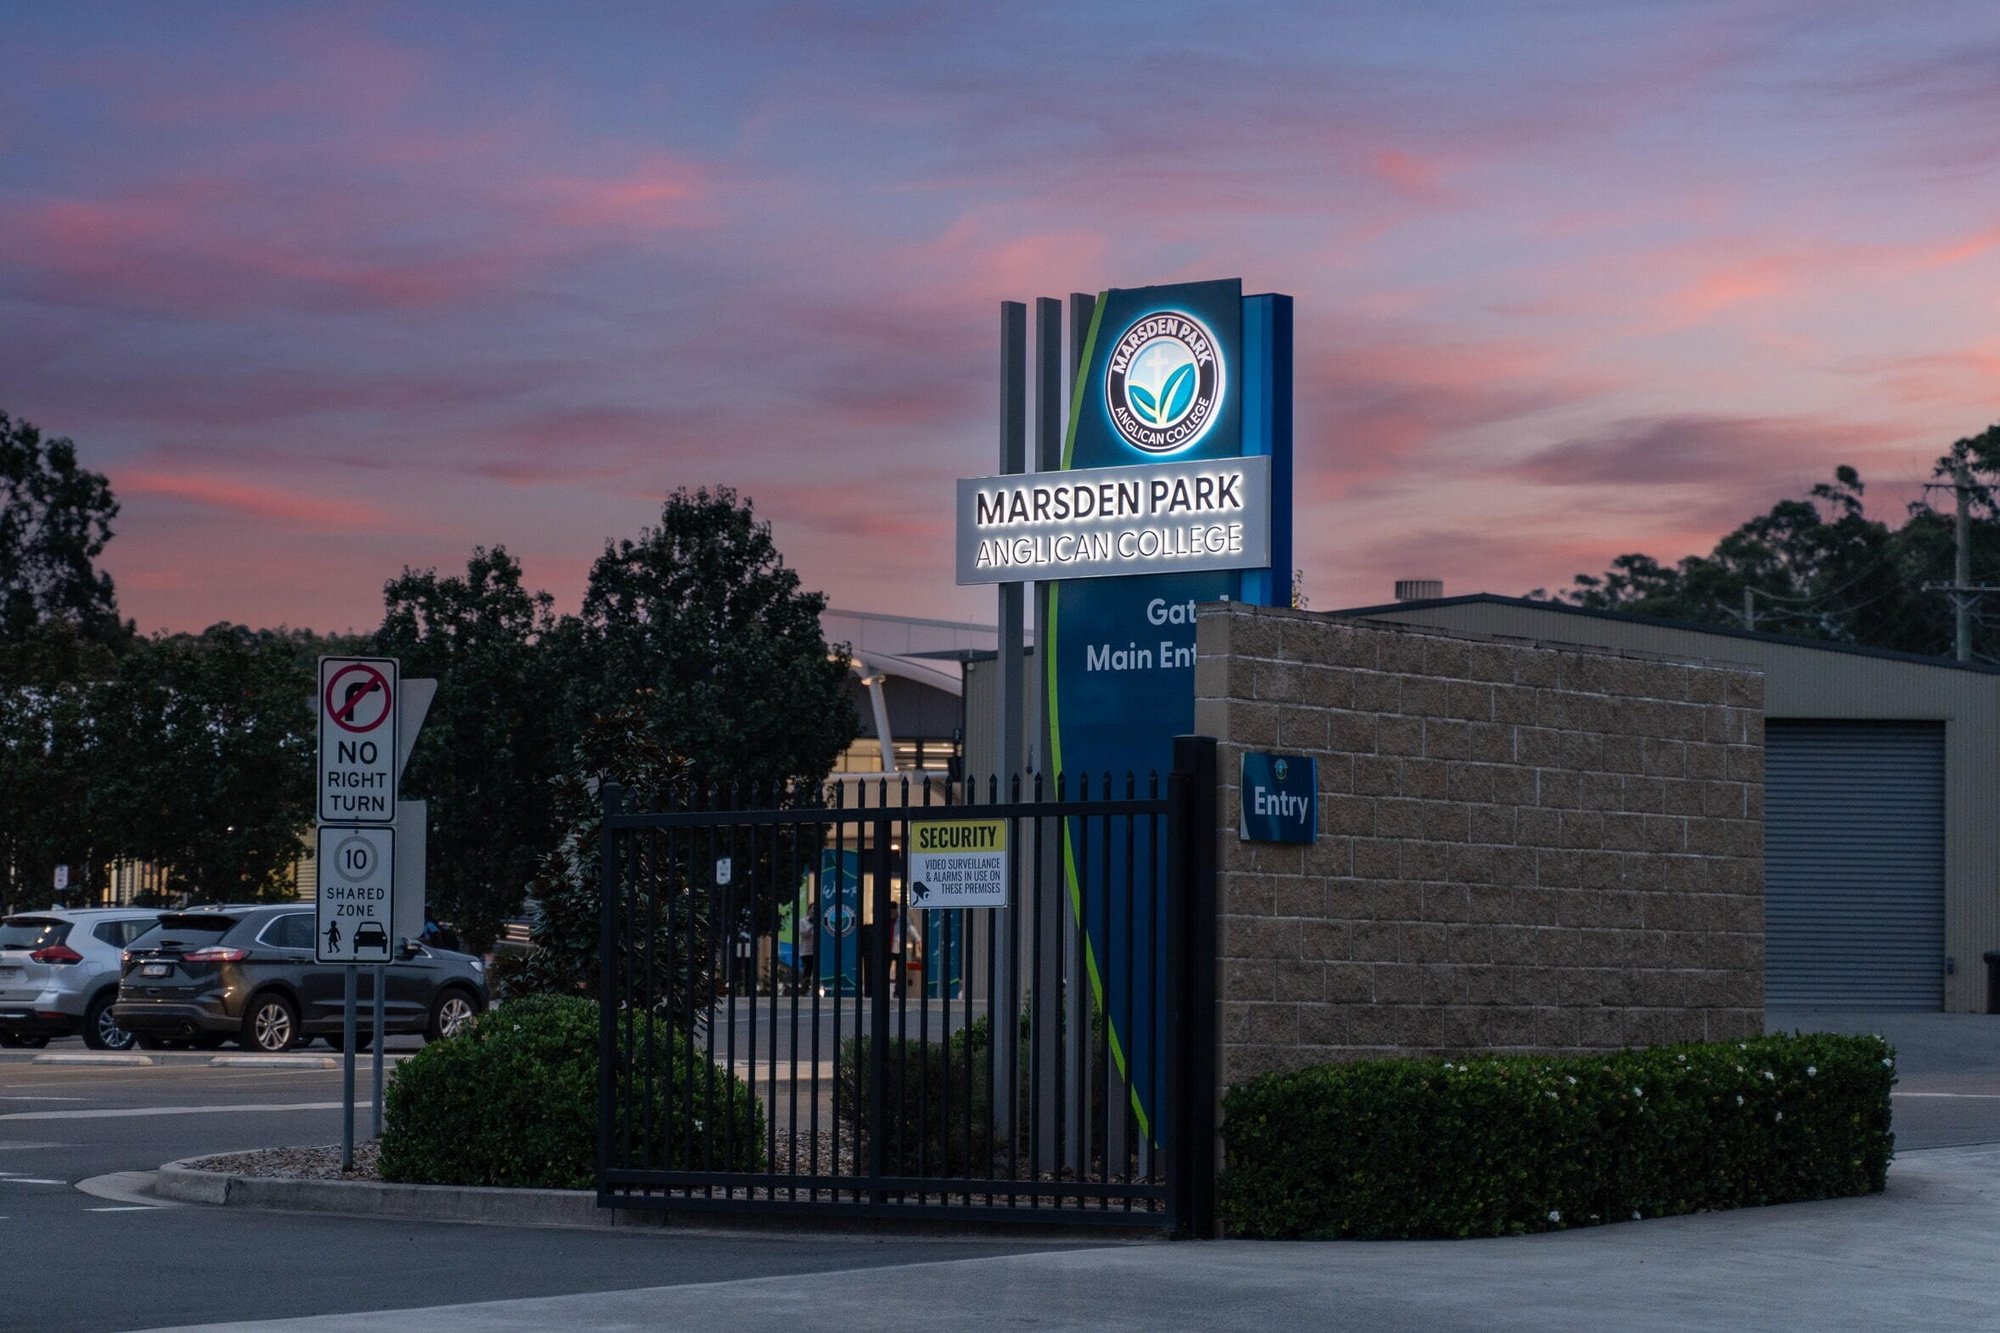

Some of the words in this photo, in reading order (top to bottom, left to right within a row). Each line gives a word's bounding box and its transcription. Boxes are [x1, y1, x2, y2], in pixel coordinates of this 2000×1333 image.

[1113, 319, 1178, 374] MARSDEN
[1178, 324, 1212, 367] PARK
[1115, 406, 1165, 445] ANGLICAN
[1166, 397, 1209, 443] COLLEGE
[976, 481, 1140, 525] MARSDEN
[1150, 474, 1242, 514] PARK
[975, 532, 1109, 568] ANGLICAN
[1117, 524, 1242, 559] COLLEGE
[1147, 598, 1197, 625] Gat
[1087, 642, 1152, 671] Main
[1160, 641, 1197, 668] Ent
[338, 741, 378, 765] NO
[328, 771, 387, 788] RIGHT
[331, 795, 385, 812] TURN
[1254, 785, 1309, 824] Entry
[920, 826, 997, 849] SECURITY
[345, 849, 367, 870] 10
[925, 859, 946, 870] VIDEO
[948, 858, 1001, 870] SURVEILLANCE
[926, 872, 931, 882] &
[933, 871, 963, 882] ALARMS
[964, 871, 972, 881] IN
[974, 871, 987, 881] USE
[990, 870, 1000, 880] ON
[327, 887, 385, 900] SHARED
[941, 884, 962, 894] THESE
[965, 883, 1001, 894] PREMISES
[337, 904, 375, 917] ZONE
